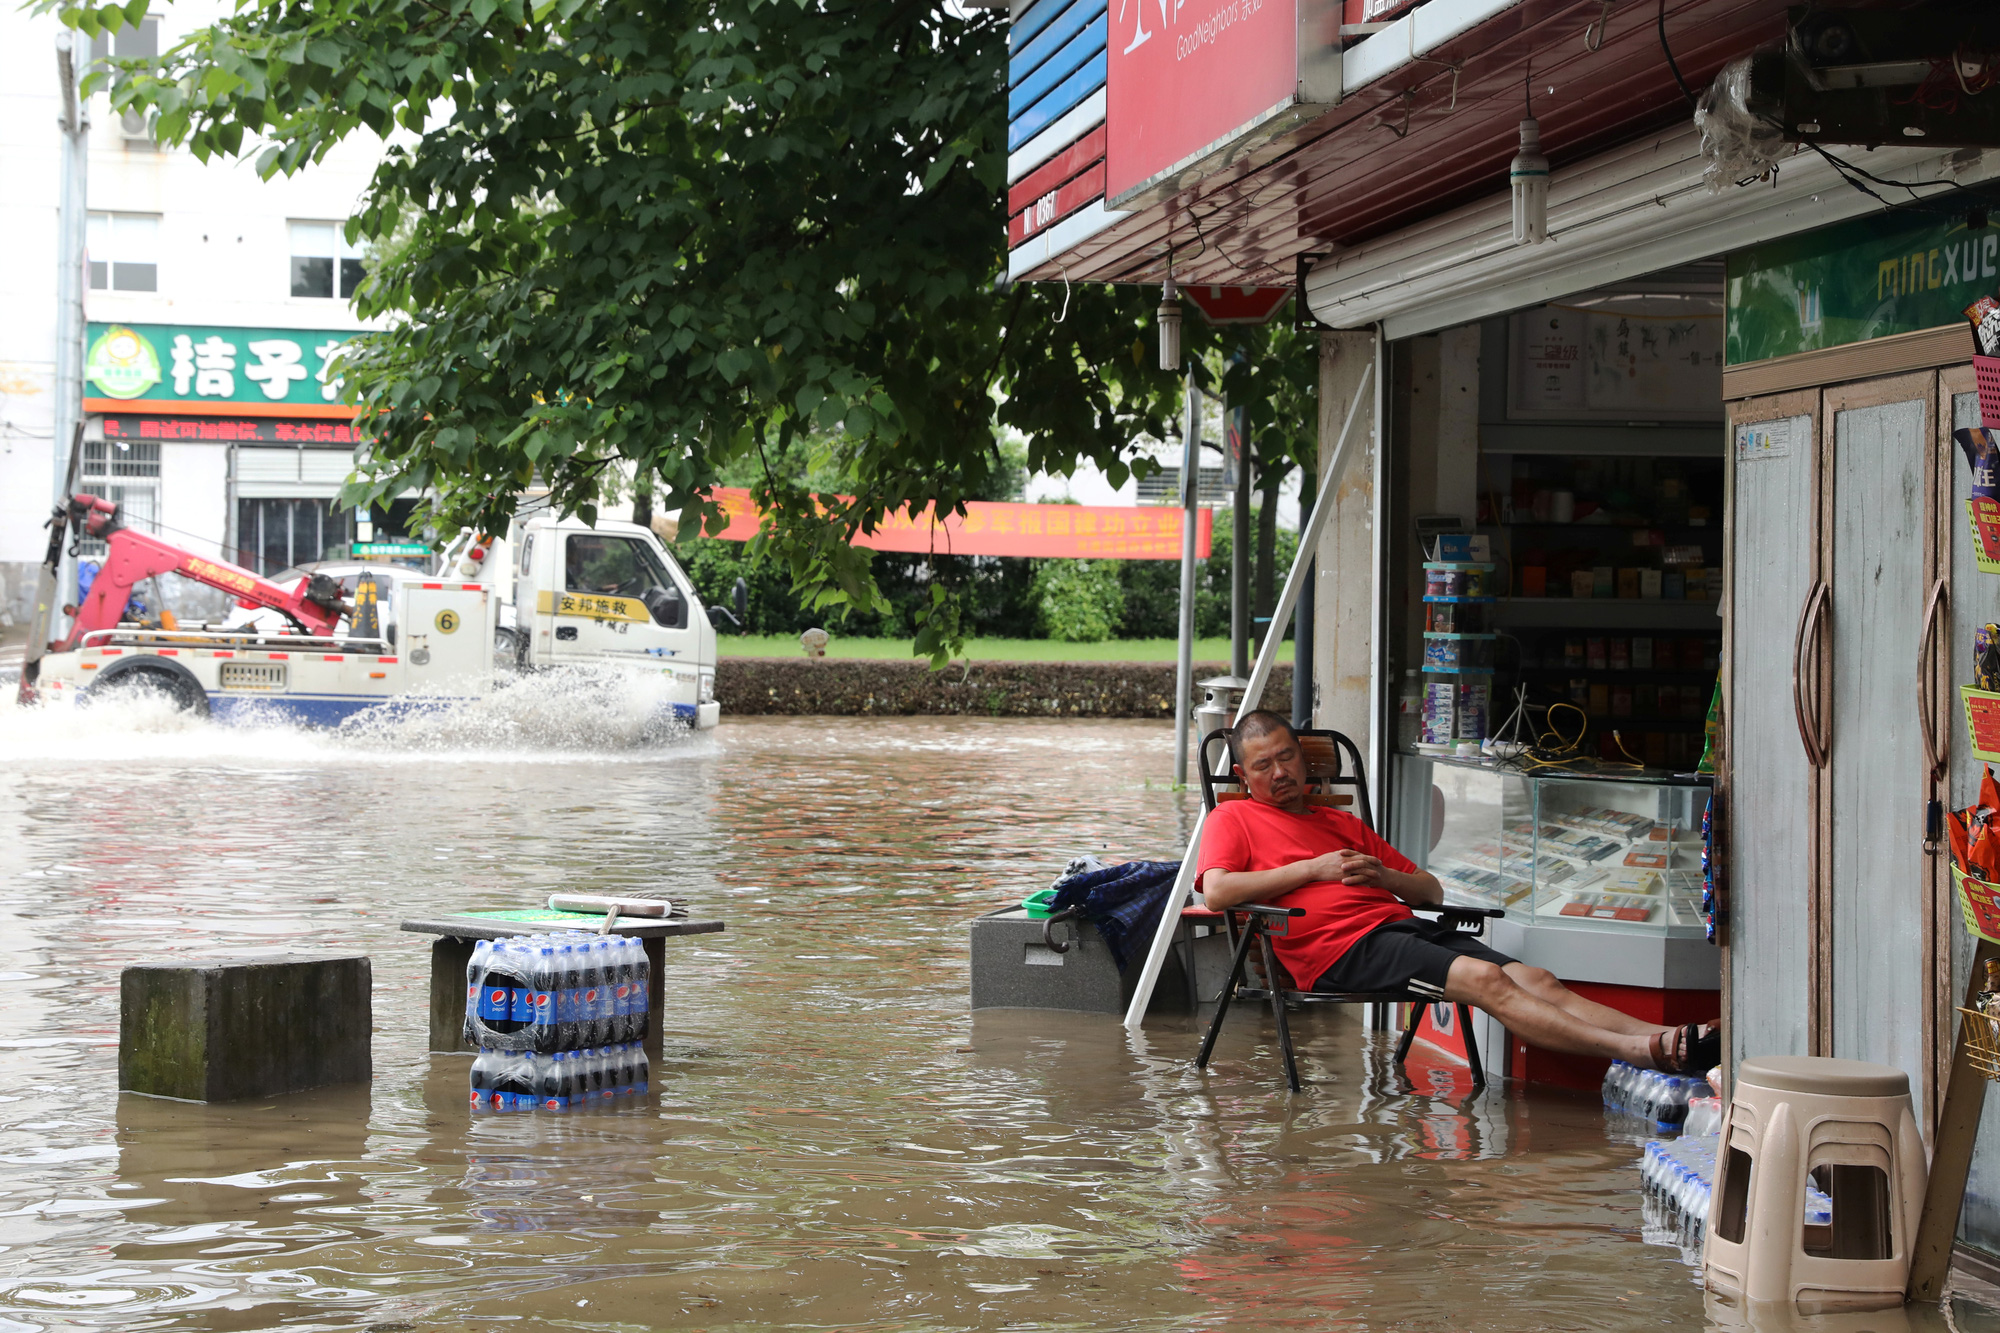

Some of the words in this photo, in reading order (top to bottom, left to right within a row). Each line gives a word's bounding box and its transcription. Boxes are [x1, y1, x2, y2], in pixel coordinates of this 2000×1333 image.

[1176, 1, 1238, 61] GoodNeighbors
[1036, 190, 1057, 227] 0367
[963, 508, 1181, 538] 参军报国建功立业
[560, 595, 628, 616] 安邦施救
[440, 613, 452, 631] 6
